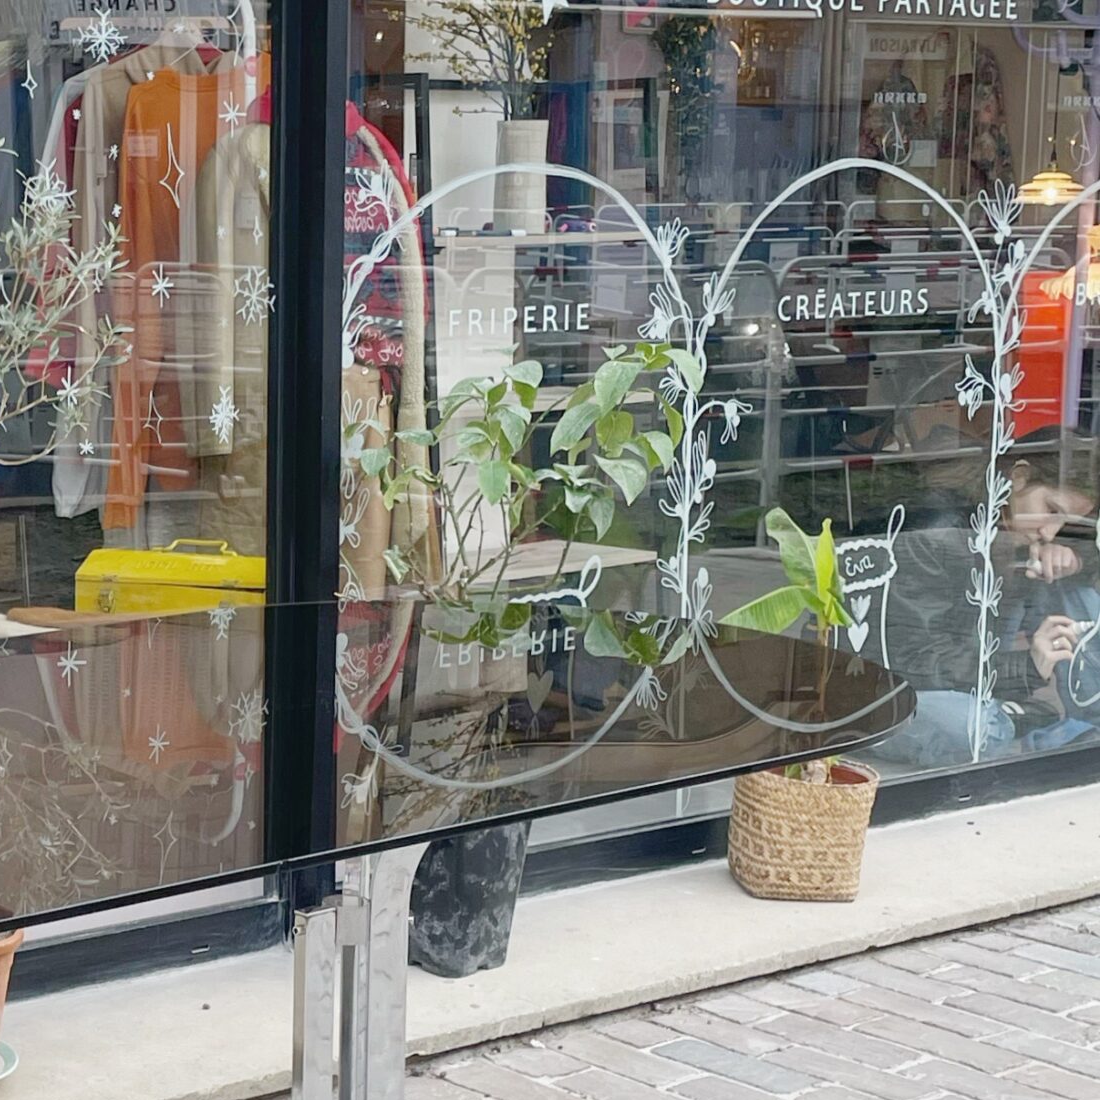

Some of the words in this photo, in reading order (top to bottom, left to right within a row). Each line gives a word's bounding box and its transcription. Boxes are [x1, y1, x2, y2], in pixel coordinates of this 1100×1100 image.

[449, 303, 590, 337] FRIPERIE
[777, 288, 929, 322] CRÉATEURS
[845, 555, 875, 577] Eva
